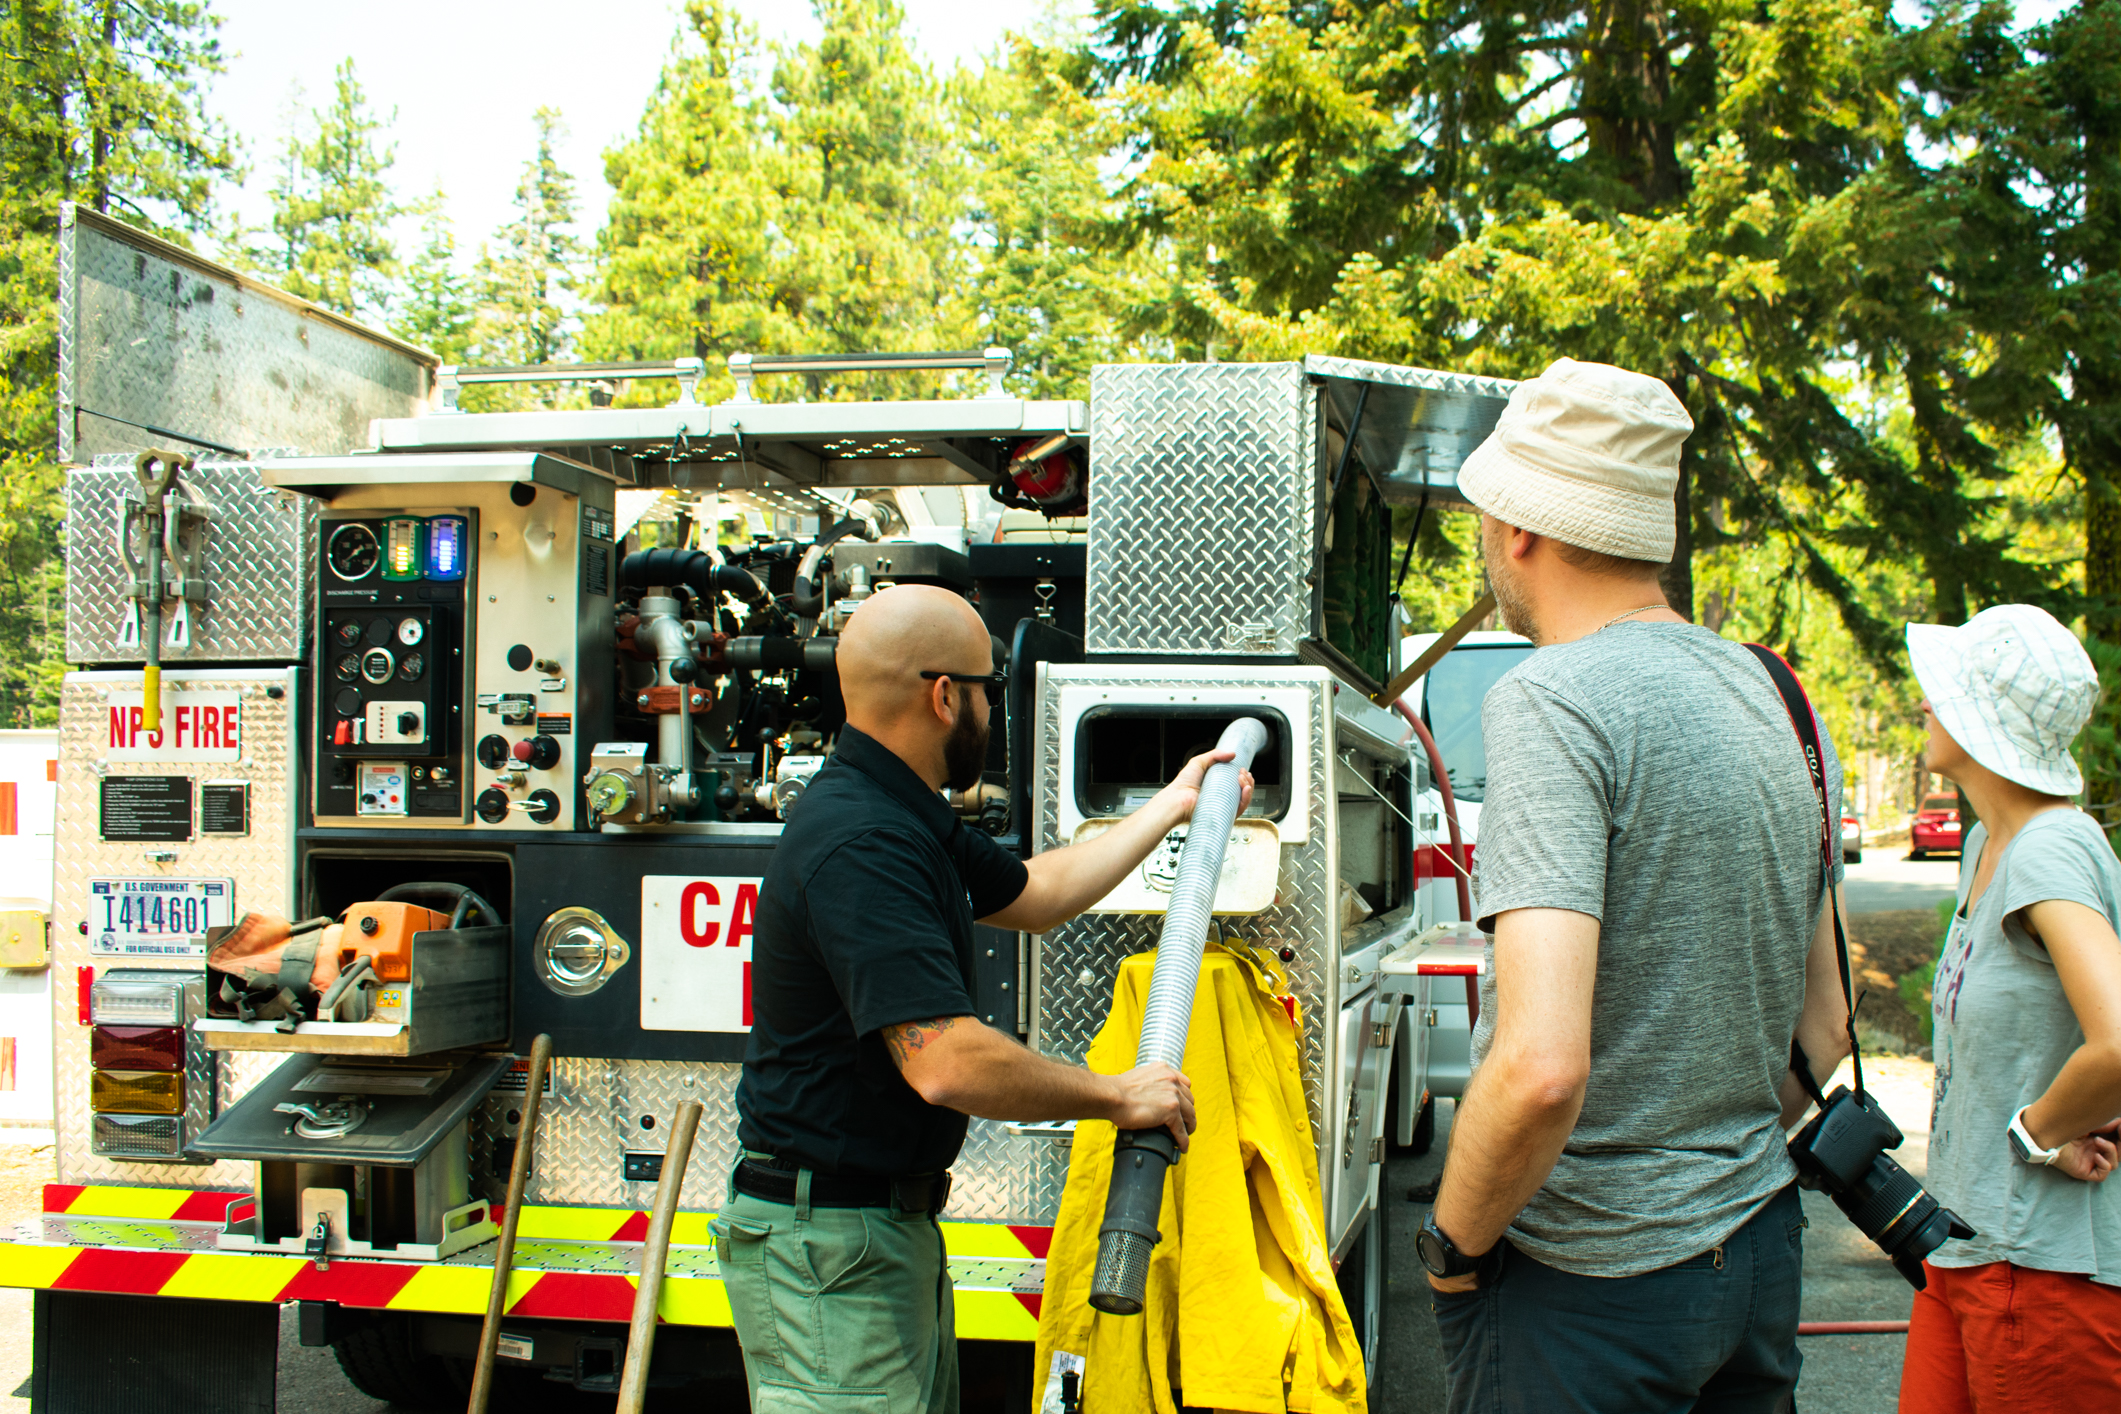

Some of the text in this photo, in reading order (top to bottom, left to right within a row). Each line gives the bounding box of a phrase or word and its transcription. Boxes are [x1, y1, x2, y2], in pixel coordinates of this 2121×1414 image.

[176, 706, 238, 748] FIRE
[125, 882, 189, 892] U.S. GOVERNMENT
[103, 895, 209, 934] I414601
[680, 881, 759, 948] CA
[125, 945, 137, 953] FOR
[138, 945, 163, 953] OFFICIAL
[177, 946, 191, 954] ONLY
